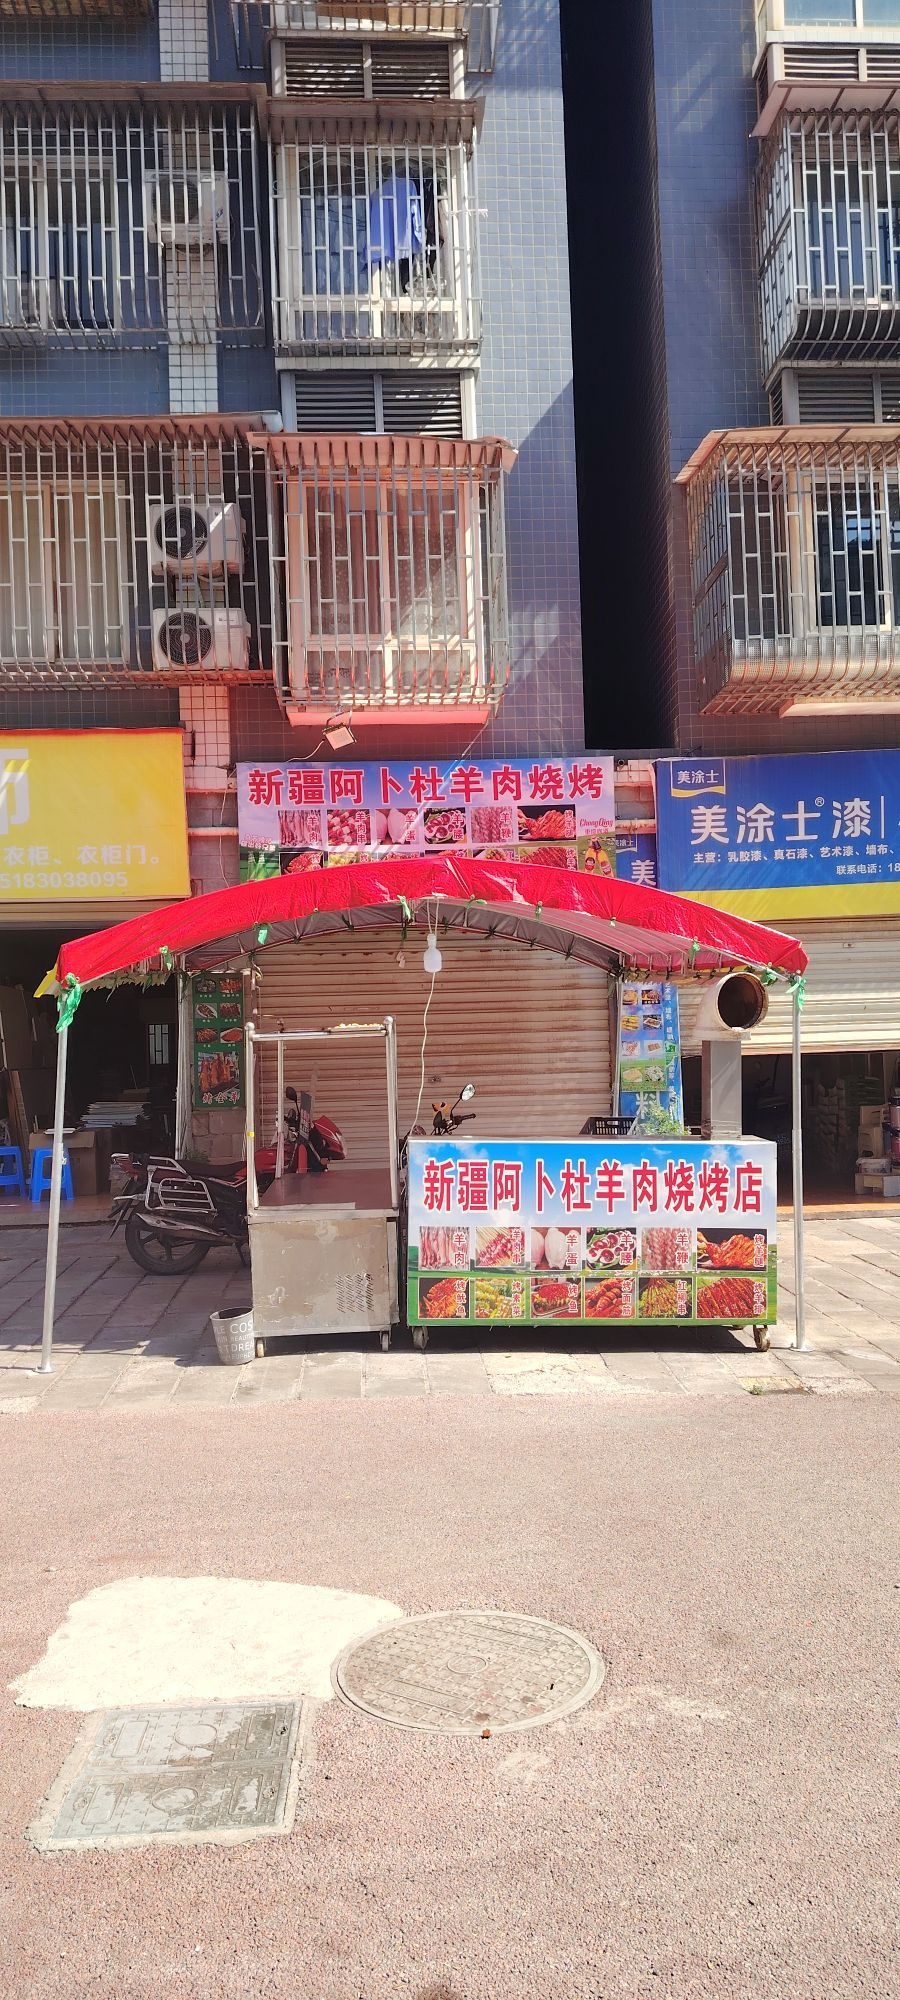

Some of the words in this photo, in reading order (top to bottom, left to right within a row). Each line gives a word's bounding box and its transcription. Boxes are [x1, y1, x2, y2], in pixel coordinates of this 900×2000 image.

[247, 765, 605, 806] 新疆阿卜杜羊肉烧烤
[677, 769, 719, 785] 美涂士
[307, 815, 319, 844] 羊肉
[355, 810, 367, 845] 羊肉串
[405, 813, 416, 842] 羊蛋
[452, 813, 465, 841] 羊腰
[630, 859, 657, 886] 美
[422, 1157, 765, 1214] 新疆阿卜杜羊肉烧烤店
[454, 1232, 466, 1266] 羊肉
[511, 1228, 522, 1264] 羊肉串
[566, 1234, 578, 1266] 羊蛋
[620, 1232, 634, 1266] 羊腰
[675, 1233, 689, 1265] 羊鞭
[455, 1279, 467, 1318] 烤鱿鱼
[511, 1281, 522, 1317] 烤素菜
[568, 1284, 579, 1313] 烤鱼
[621, 1280, 633, 1316] 烤面筋
[676, 1280, 688, 1316] 红柳串
[753, 1283, 765, 1315] 烤羊排
